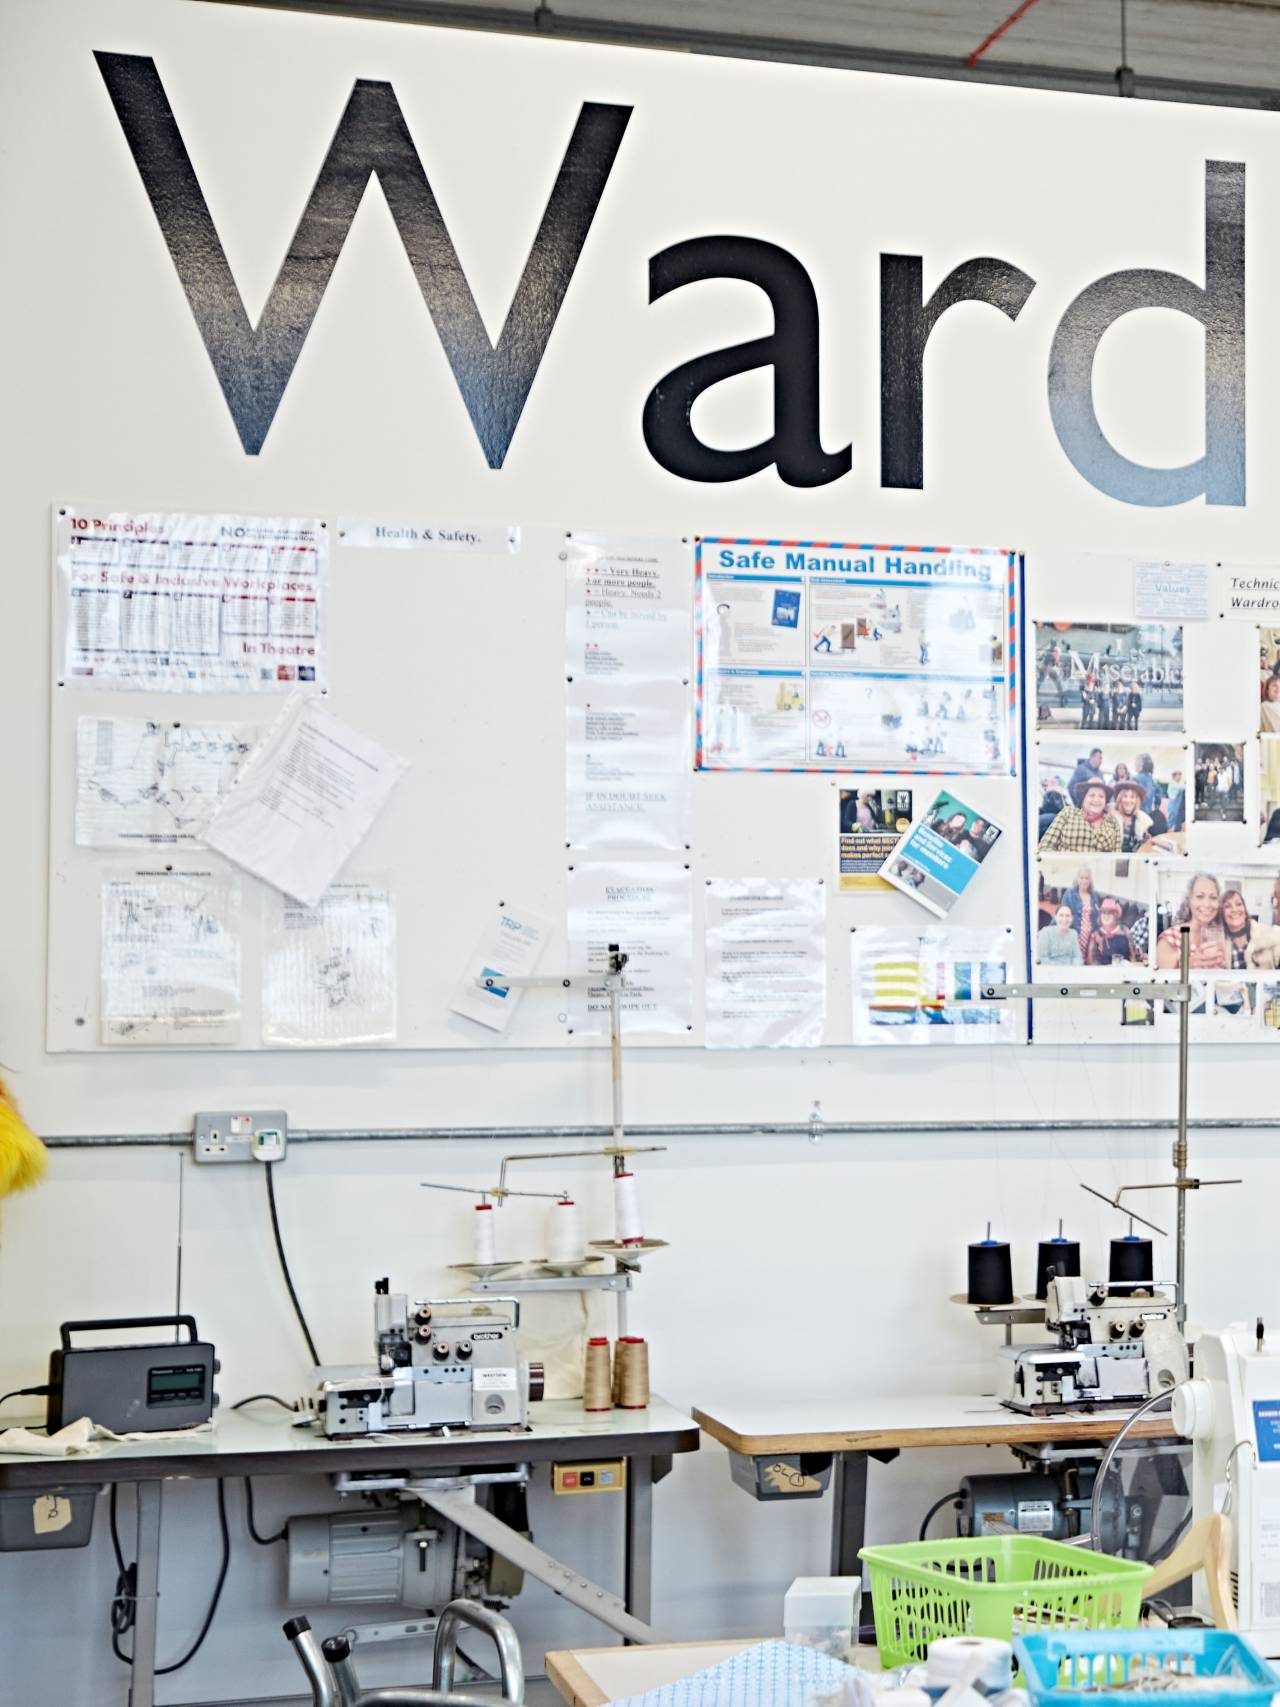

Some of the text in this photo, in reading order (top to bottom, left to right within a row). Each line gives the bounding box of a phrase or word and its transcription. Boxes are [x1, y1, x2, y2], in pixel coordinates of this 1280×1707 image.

[71, 518, 88, 530] 10
[375, 526, 481, 545] Health & Safety.
[719, 550, 992, 583] Safe Manual Handling
